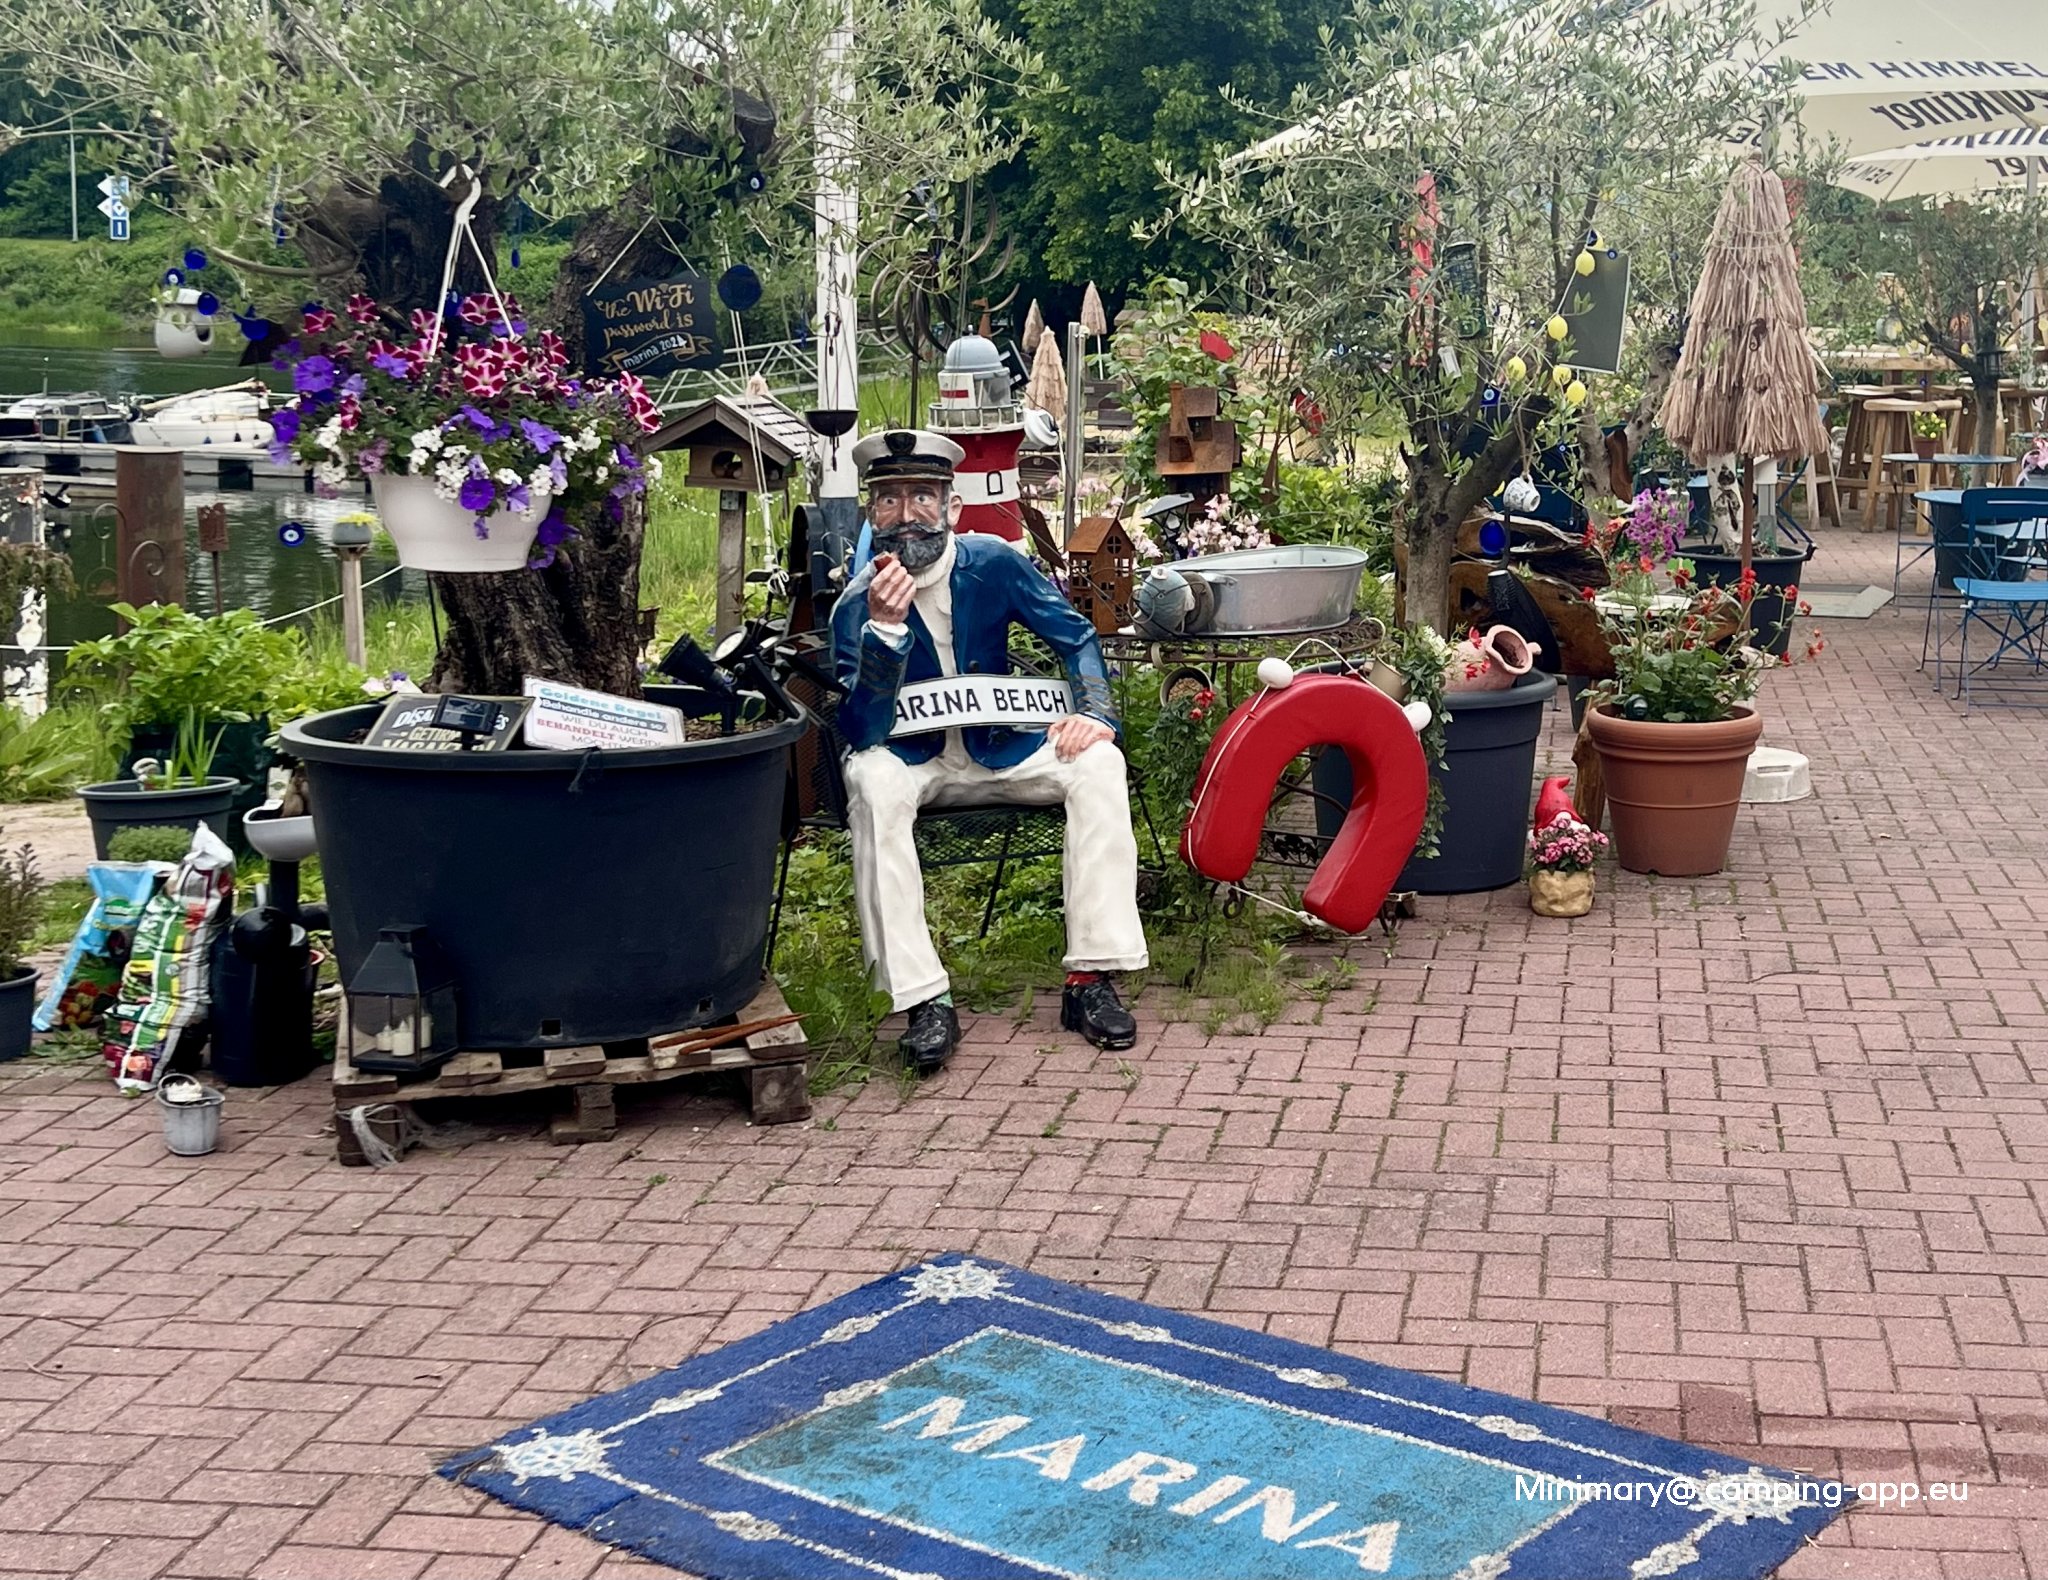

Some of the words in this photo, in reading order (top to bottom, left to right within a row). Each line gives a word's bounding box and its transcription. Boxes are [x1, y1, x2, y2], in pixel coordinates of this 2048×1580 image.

[594, 299, 632, 319] the
[626, 284, 695, 313] Wi-Fi
[603, 309, 671, 350] password
[676, 312, 694, 328] is
[623, 345, 660, 369] marina
[540, 688, 609, 709] Goldene
[614, 703, 661, 720] Regel
[541, 699, 600, 718] Behandle
[601, 713, 648, 727] andere
[993, 688, 1068, 714] BEACH
[536, 719, 616, 740] BEHANDELT
[562, 714, 585, 725] WIE
[588, 719, 607, 730] DU
[610, 725, 648, 737] AUCH
[878, 1397, 1401, 1573] MARINA
